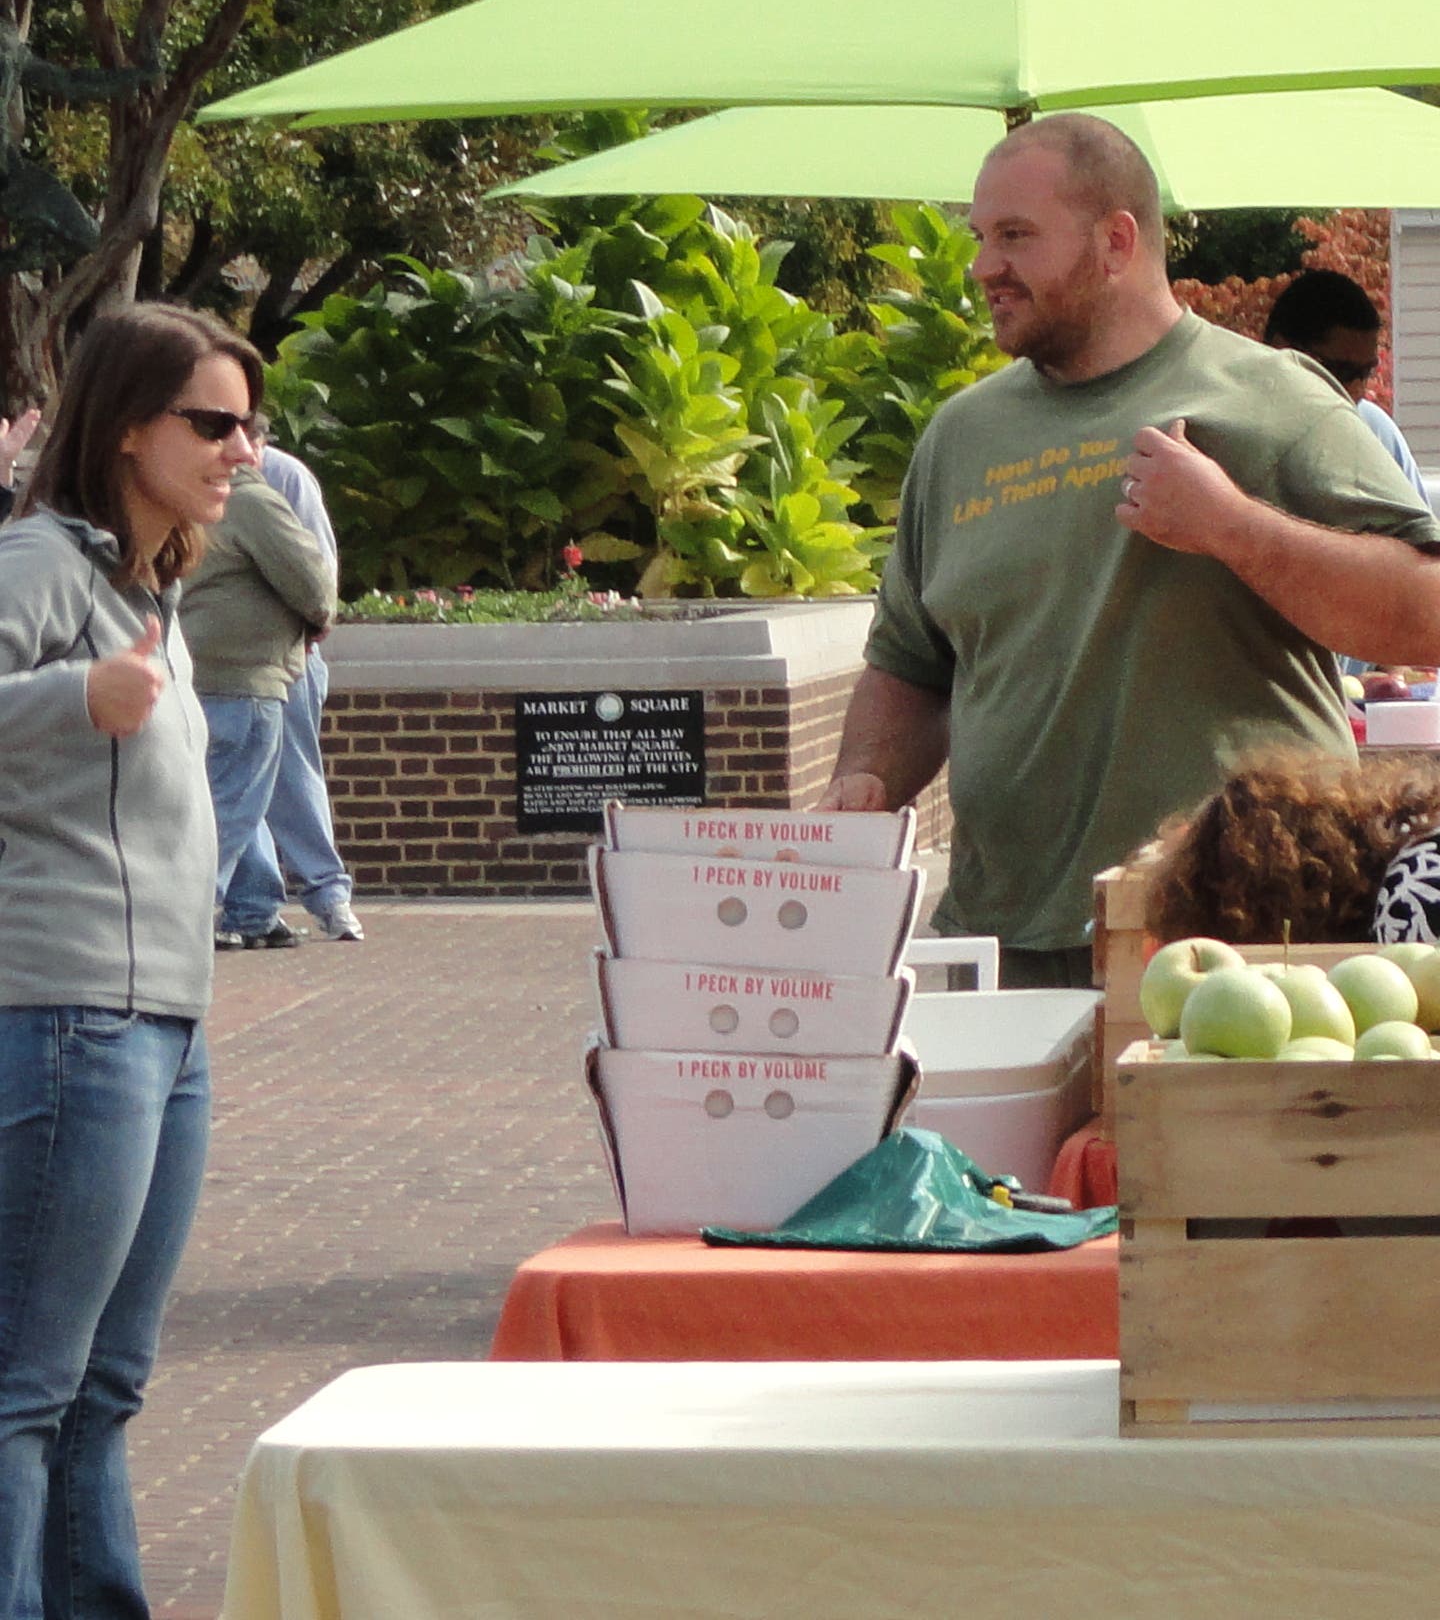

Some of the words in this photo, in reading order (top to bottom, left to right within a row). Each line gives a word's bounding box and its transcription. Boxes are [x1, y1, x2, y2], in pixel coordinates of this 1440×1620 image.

[985, 457, 1034, 487] How
[1039, 447, 1070, 469] Do
[1001, 475, 1057, 506] Them
[1062, 458, 1131, 489] Apple
[523, 700, 588, 715] MARKET
[630, 697, 690, 713] SQUARE
[535, 731, 550, 741] TO
[554, 730, 599, 741] ENSURE
[602, 729, 633, 740] THAT
[637, 729, 657, 740] ALL
[660, 728, 685, 739] MAY
[579, 741, 627, 751] MARKET
[530, 753, 552, 764] THE
[557, 753, 624, 764] FOLLOWING
[628, 751, 692, 762] ACTIVITIES
[526, 765, 548, 776] ARE
[553, 764, 624, 776] PROHIBITED
[628, 763, 641, 774] BY
[646, 763, 669, 774] THE
[684, 820, 690, 837] 1
[697, 821, 737, 840] PECK
[744, 822, 764, 840] BY
[770, 823, 833, 842] VOLUME
[693, 867, 699, 883] 1
[706, 867, 746, 885] PECK
[753, 870, 773, 887] BY
[779, 872, 843, 892] VOLUME
[685, 973, 690, 991] 1
[698, 973, 738, 994] PECK
[744, 977, 764, 994] BY
[771, 980, 835, 1000] VOLUME
[677, 1061, 683, 1077] 1
[691, 1060, 731, 1078] PECK
[738, 1062, 757, 1079] BY
[764, 1062, 827, 1080] VOLUME
